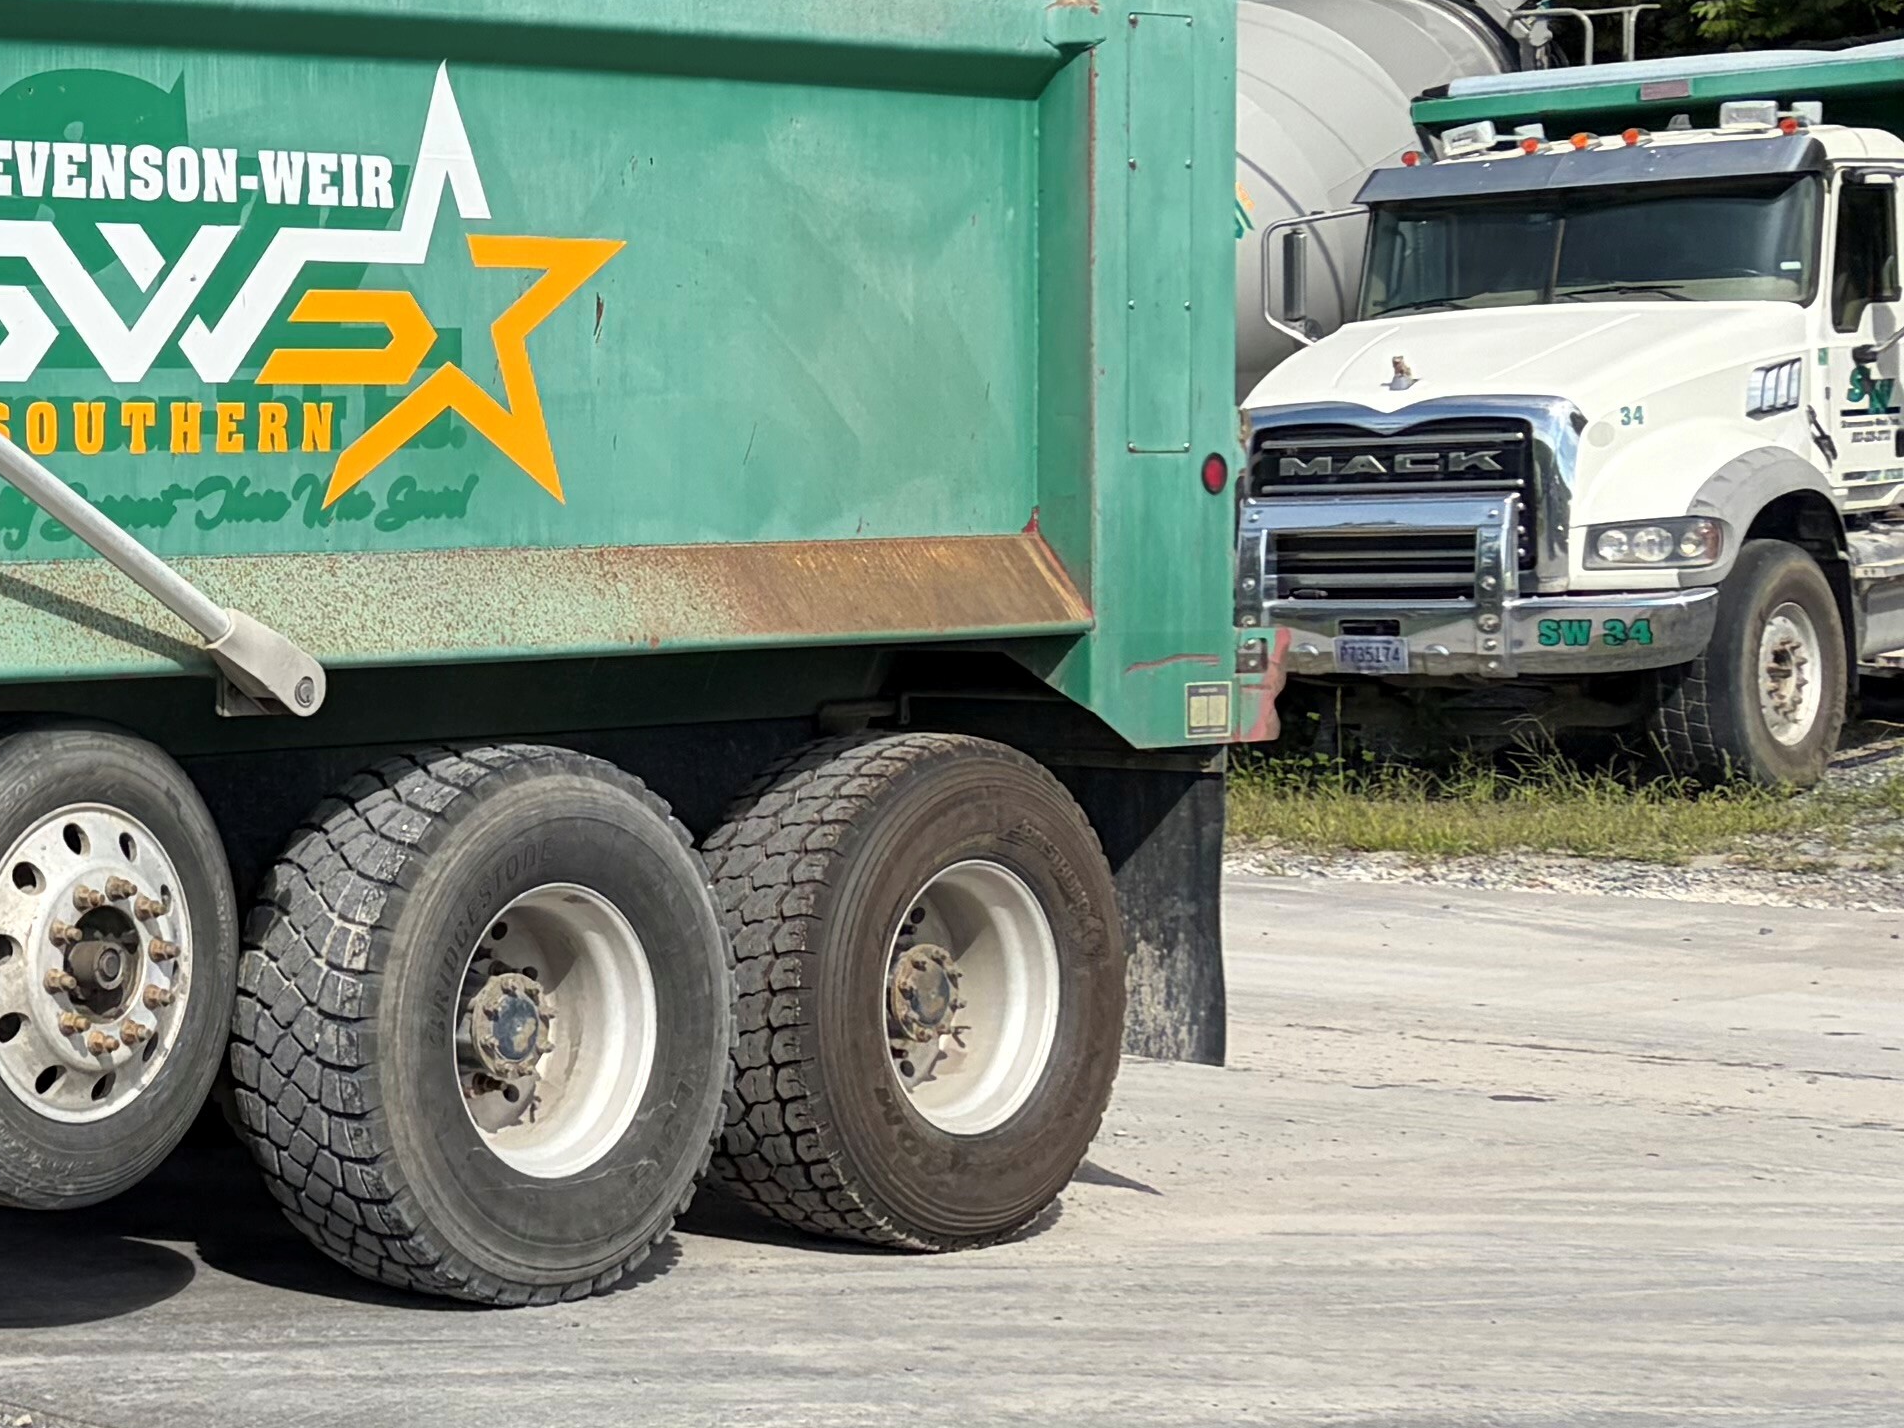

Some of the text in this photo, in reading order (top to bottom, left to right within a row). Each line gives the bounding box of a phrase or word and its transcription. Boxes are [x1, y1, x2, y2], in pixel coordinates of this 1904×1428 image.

[1620, 405, 1645, 427] 34
[1279, 450, 1505, 477] MACK
[1538, 619, 1653, 646] SW 34
